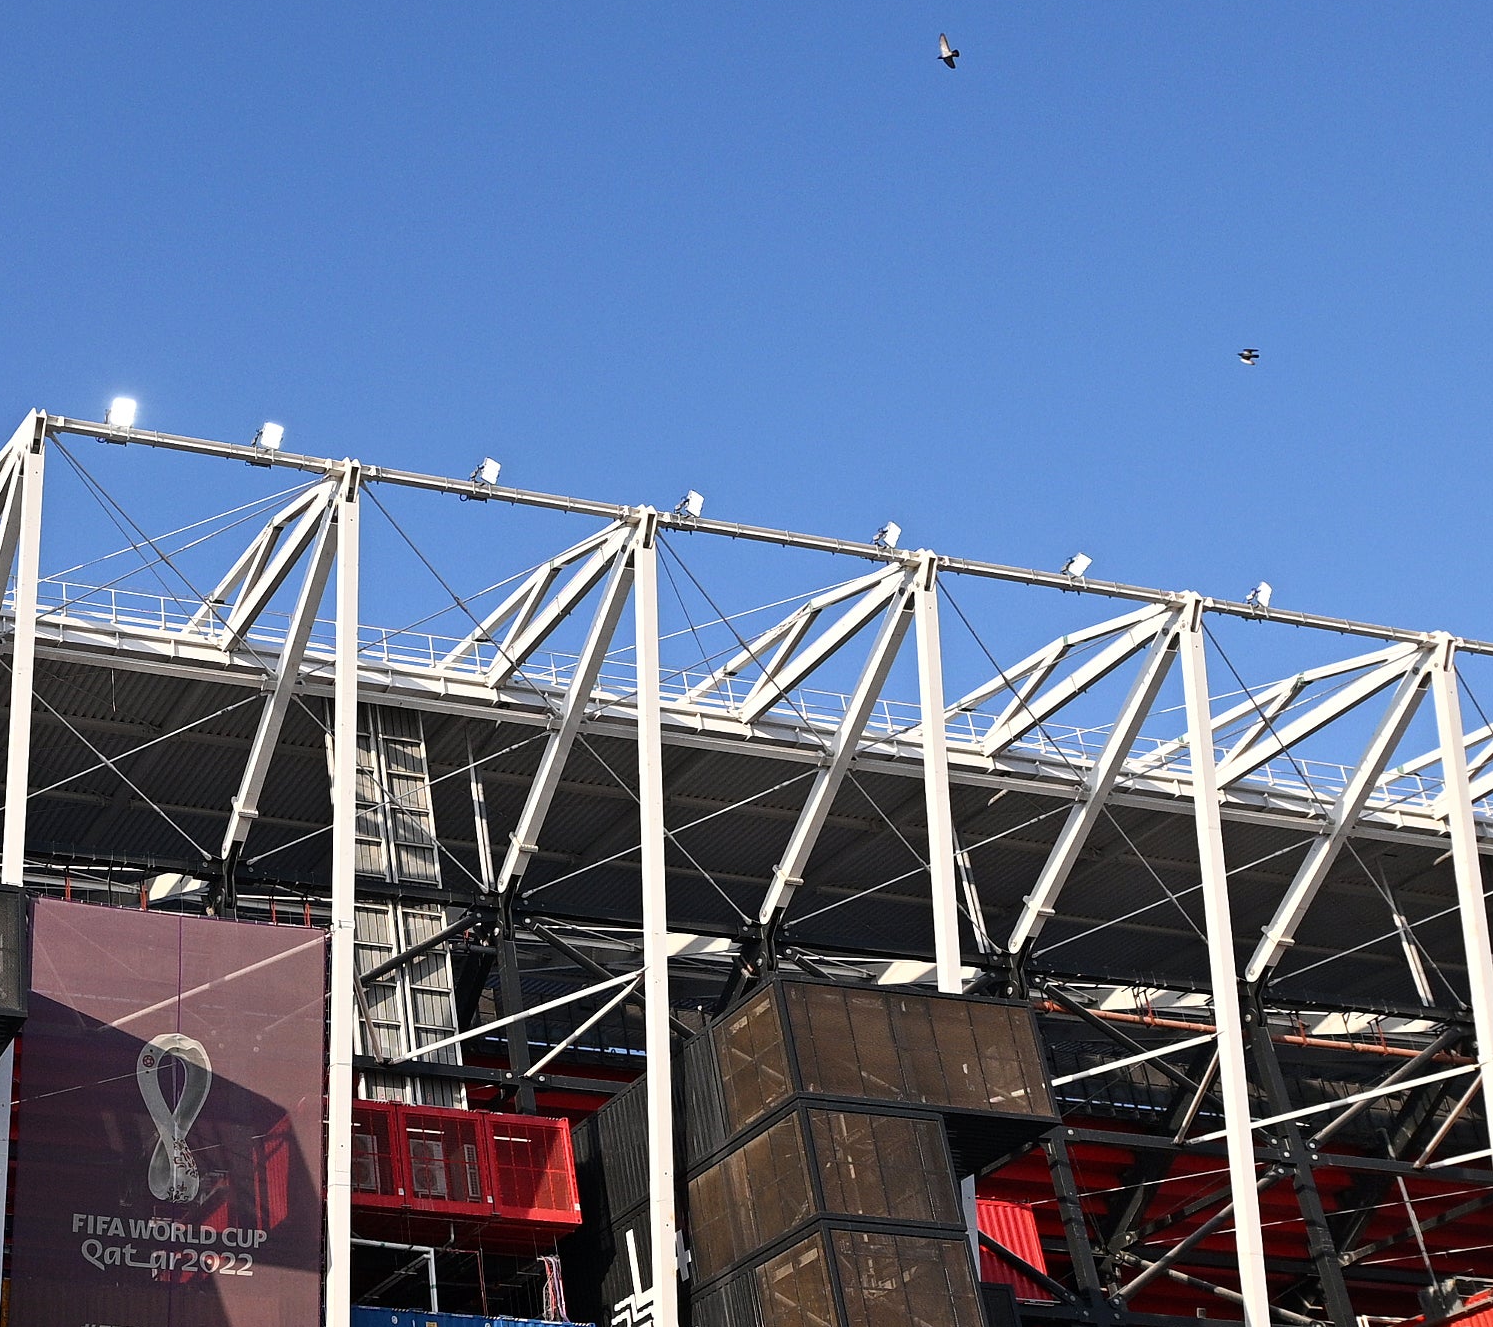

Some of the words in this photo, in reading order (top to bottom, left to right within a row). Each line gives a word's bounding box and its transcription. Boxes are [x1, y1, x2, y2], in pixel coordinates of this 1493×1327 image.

[72, 1213, 125, 1237] FIFA
[129, 1218, 217, 1245] WORLD
[221, 1227, 268, 1249] CUP
